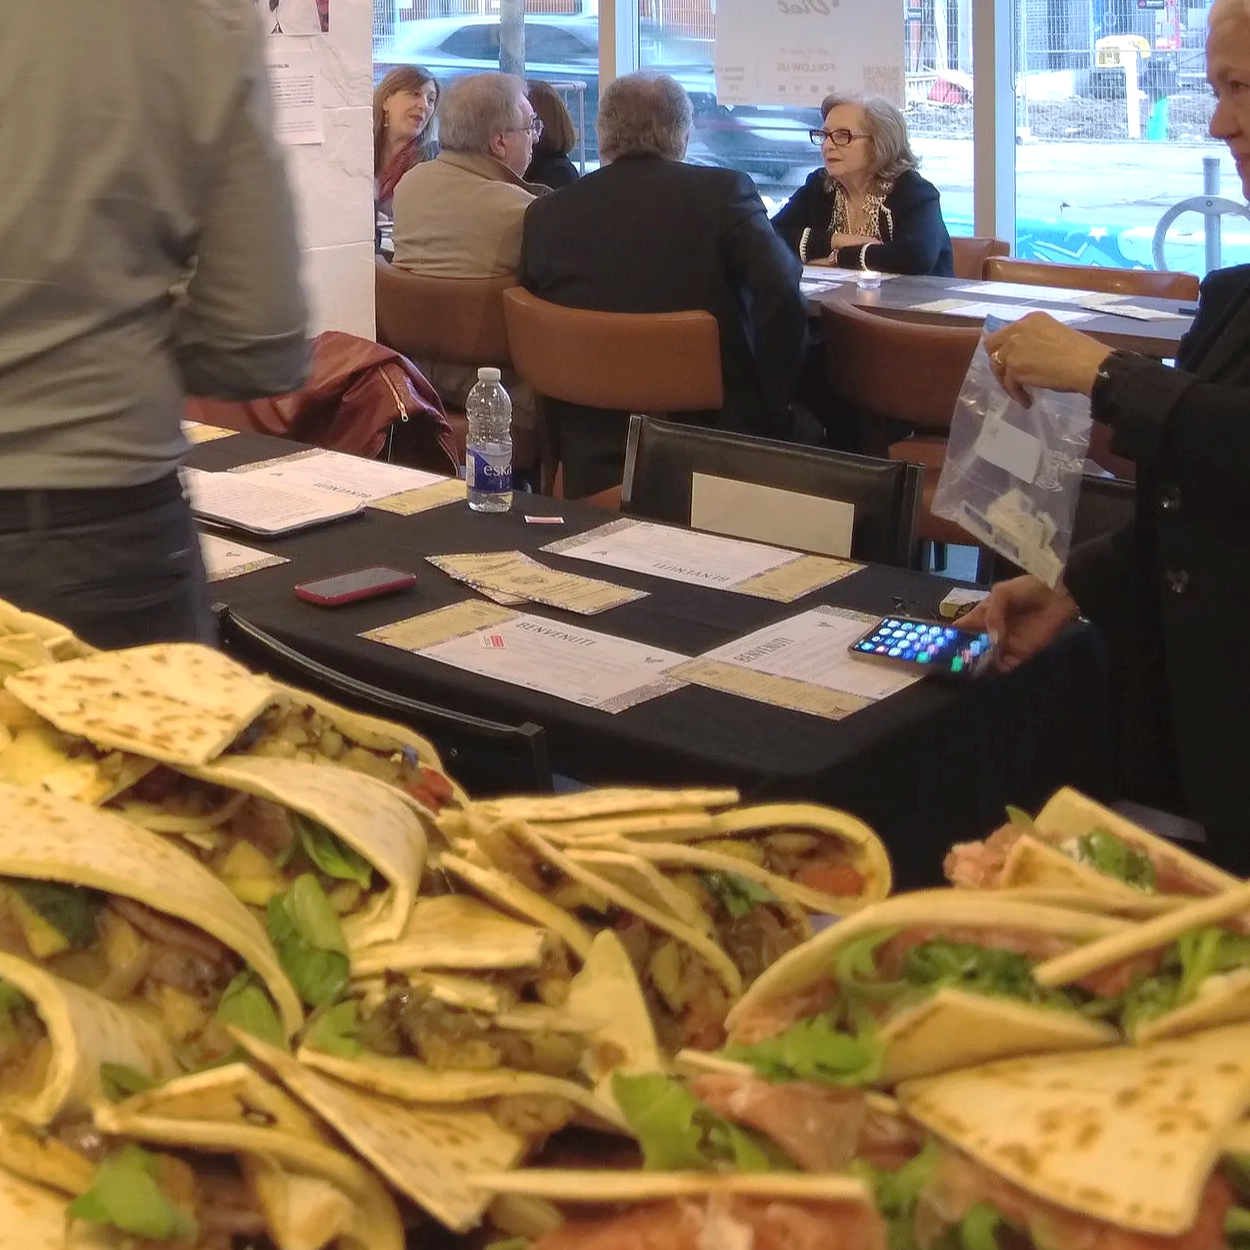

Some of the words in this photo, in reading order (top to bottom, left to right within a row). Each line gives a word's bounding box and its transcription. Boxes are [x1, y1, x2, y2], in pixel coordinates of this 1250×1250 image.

[652, 562, 731, 582] BENVENUTI
[516, 621, 597, 647] BENVENUTI
[733, 636, 797, 663] BENVENUTI
